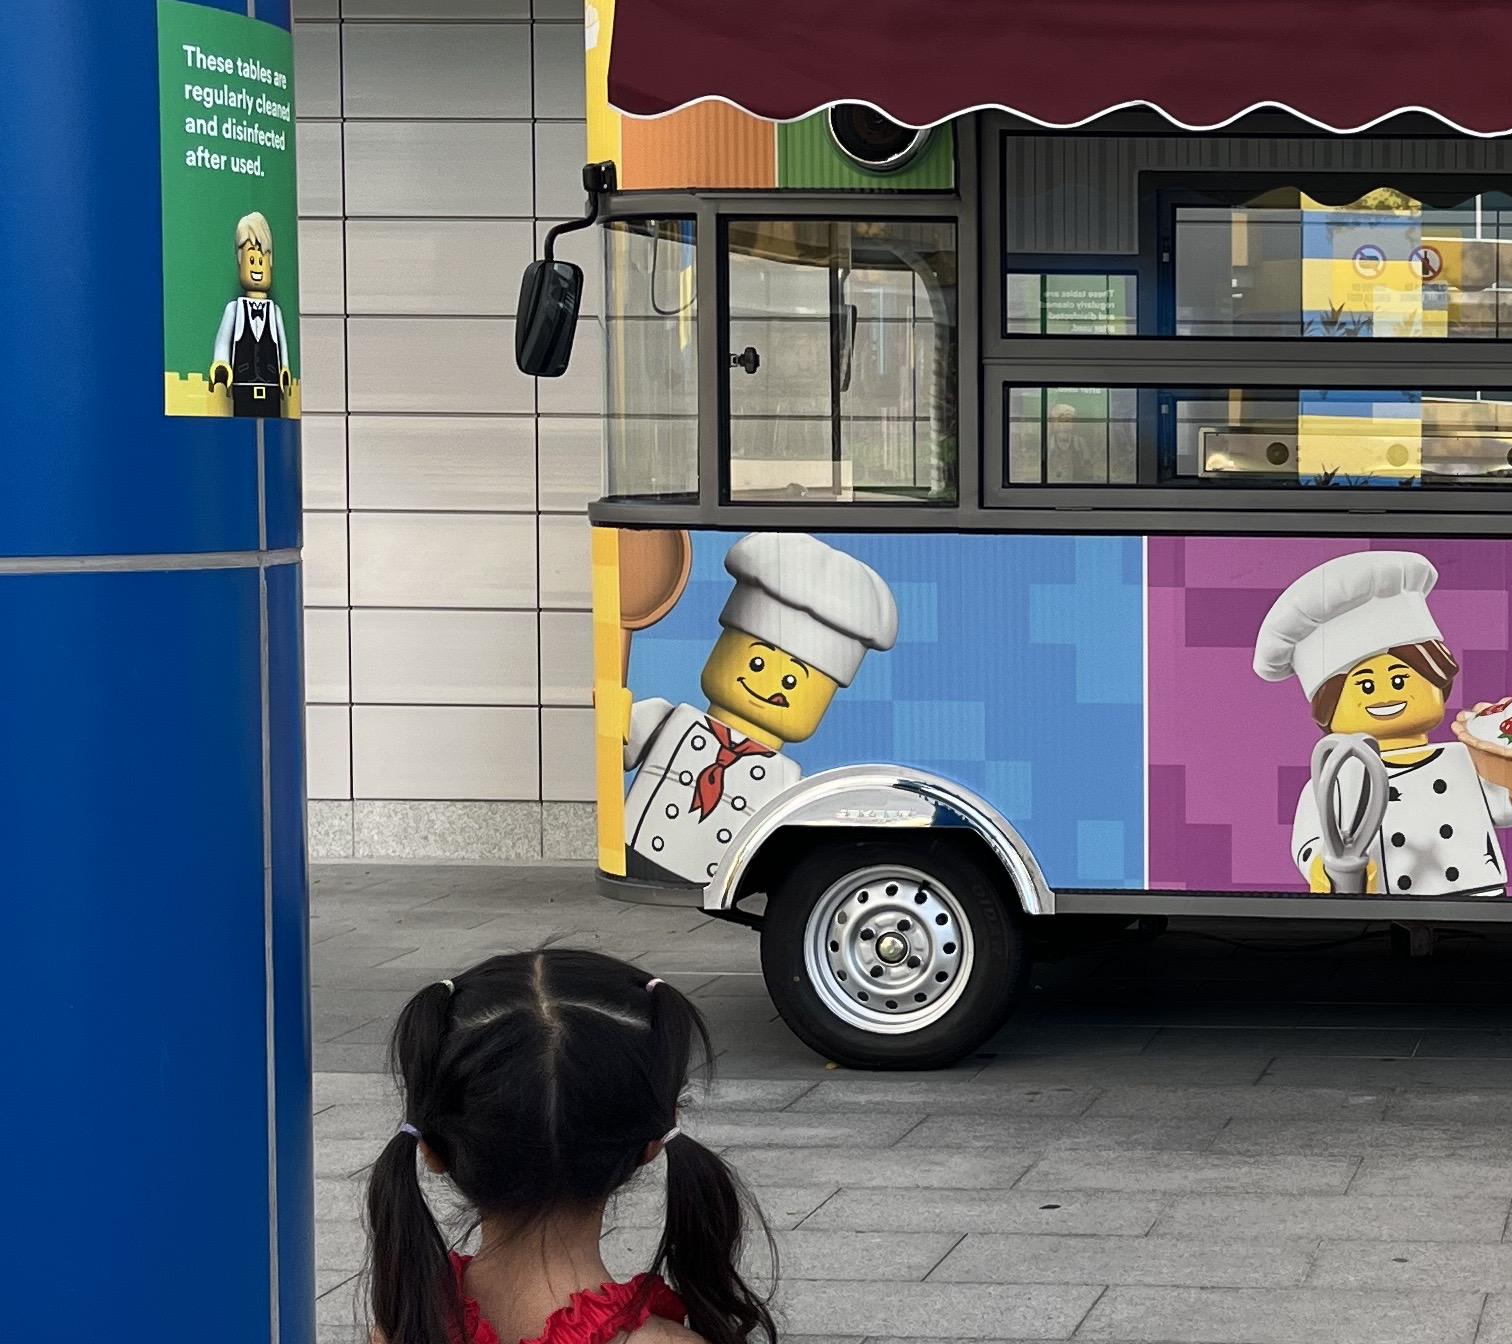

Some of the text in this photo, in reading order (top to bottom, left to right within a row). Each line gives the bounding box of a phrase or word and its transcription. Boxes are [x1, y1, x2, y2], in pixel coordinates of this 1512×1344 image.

[182, 44, 287, 90] These tables are
[184, 83, 291, 122] regularly cleaned
[185, 115, 286, 151] and disinfected
[185, 145, 265, 177] after used.
